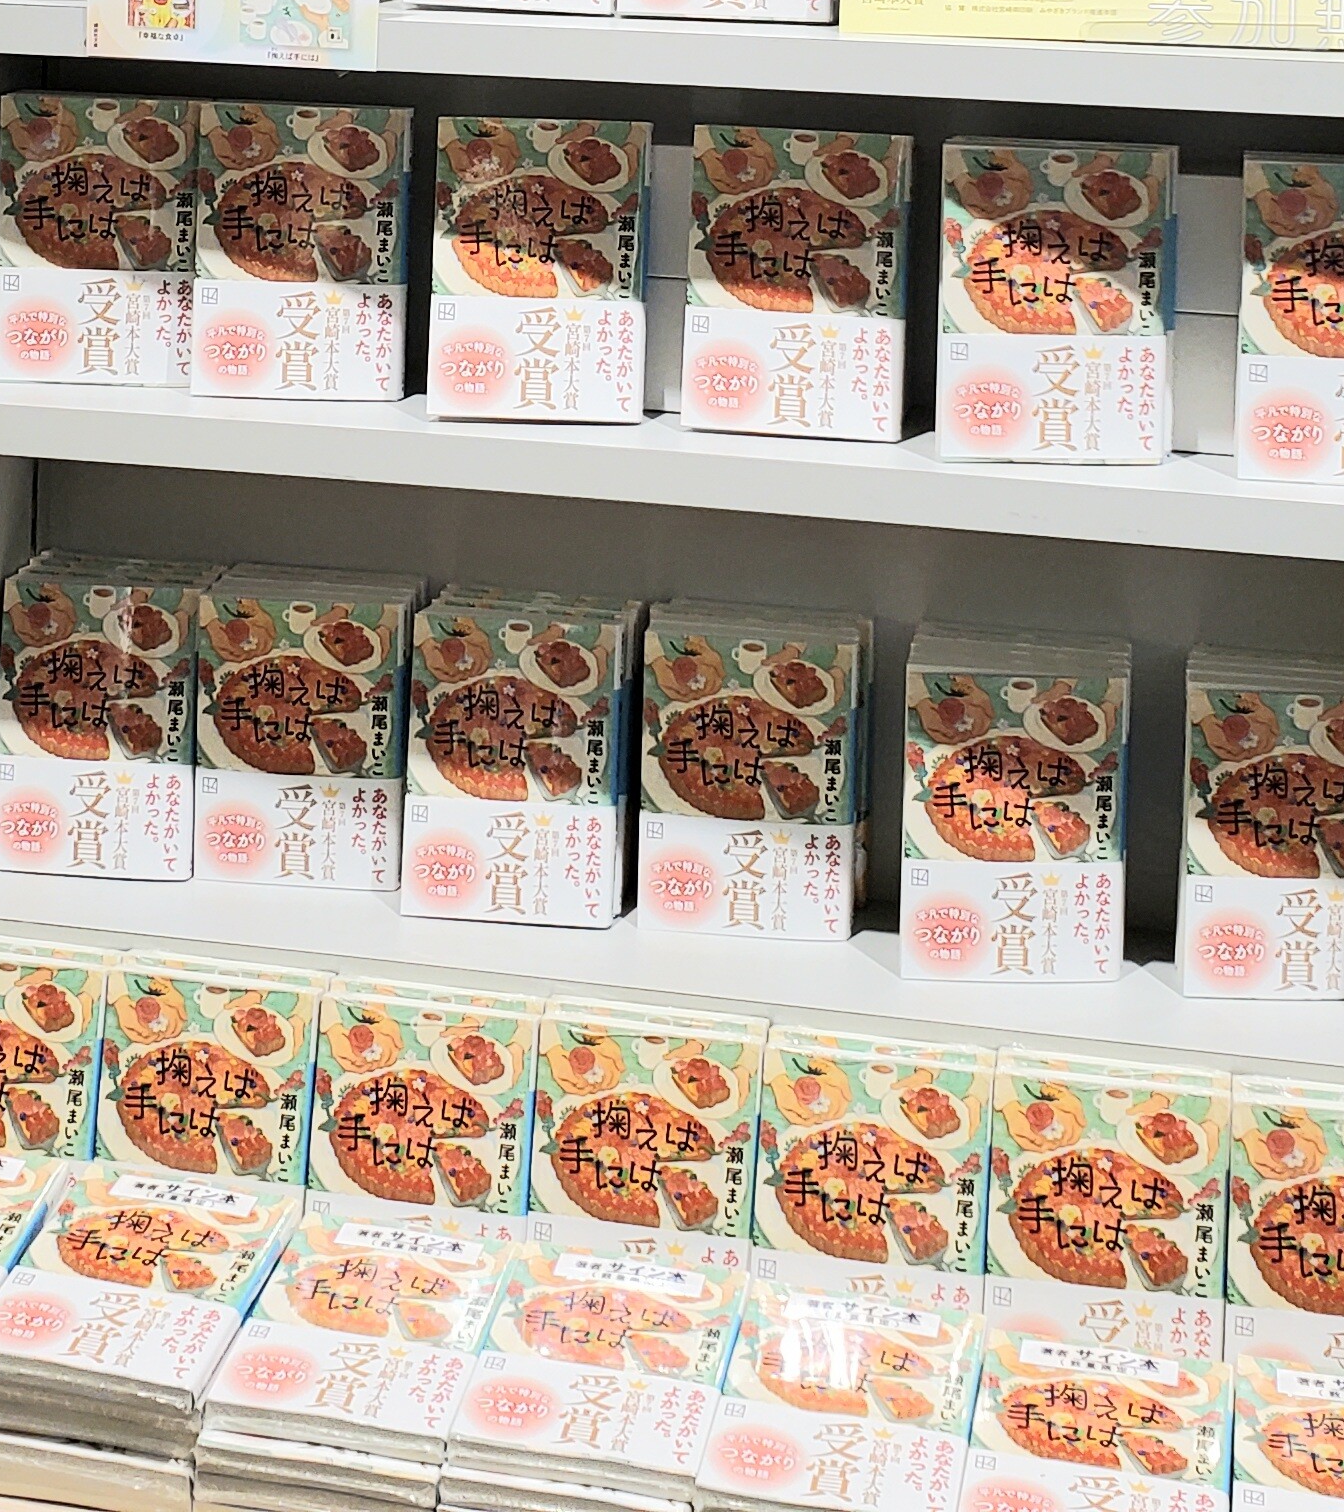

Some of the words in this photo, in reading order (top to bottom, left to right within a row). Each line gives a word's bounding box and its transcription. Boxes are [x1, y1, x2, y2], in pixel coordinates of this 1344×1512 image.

[933, 781, 1036, 830] 手には
[277, 1092, 299, 1184] 瀬尾まいこ
[1052, 1156, 1170, 1211] 掬えば
